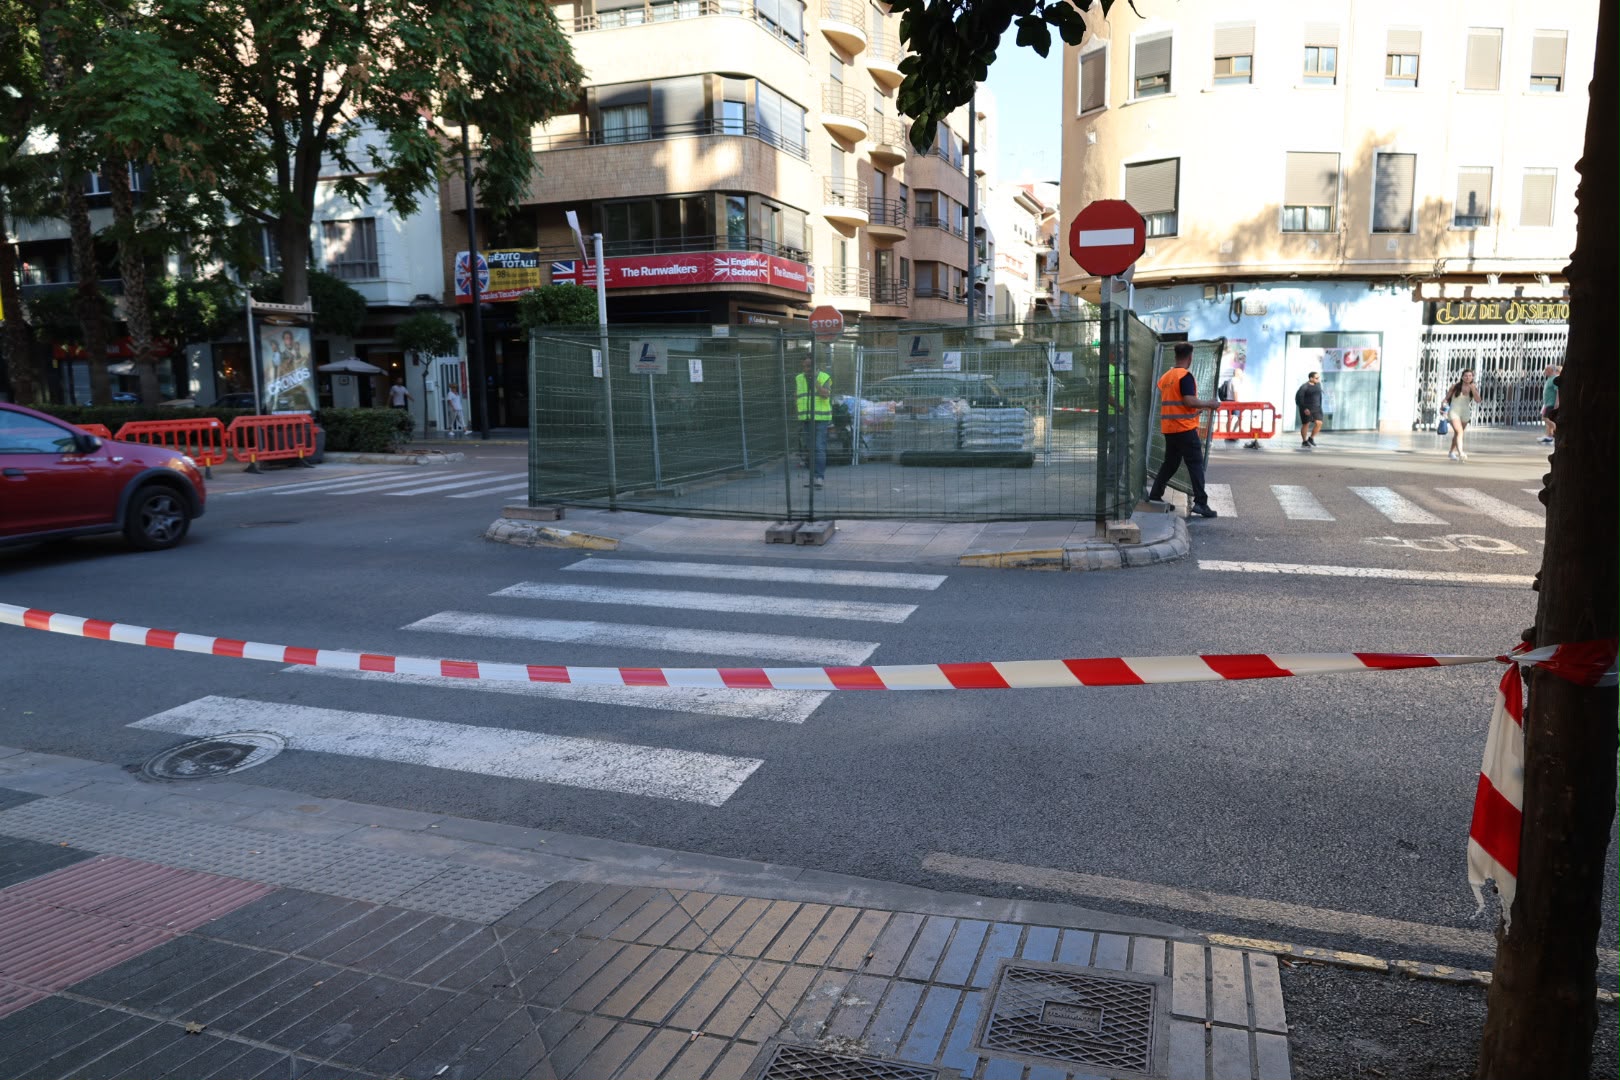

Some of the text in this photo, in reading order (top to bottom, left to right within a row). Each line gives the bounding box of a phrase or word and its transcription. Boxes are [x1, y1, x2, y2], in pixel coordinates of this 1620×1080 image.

[730, 258, 759, 267] English
[620, 267, 640, 278] The
[641, 264, 698, 277] Runwalkers
[730, 268, 758, 277] School
[1436, 301, 1570, 324] LUZ DEL DESIERTO
[811, 318, 839, 329] STOP
[267, 366, 311, 396] CRONOS
